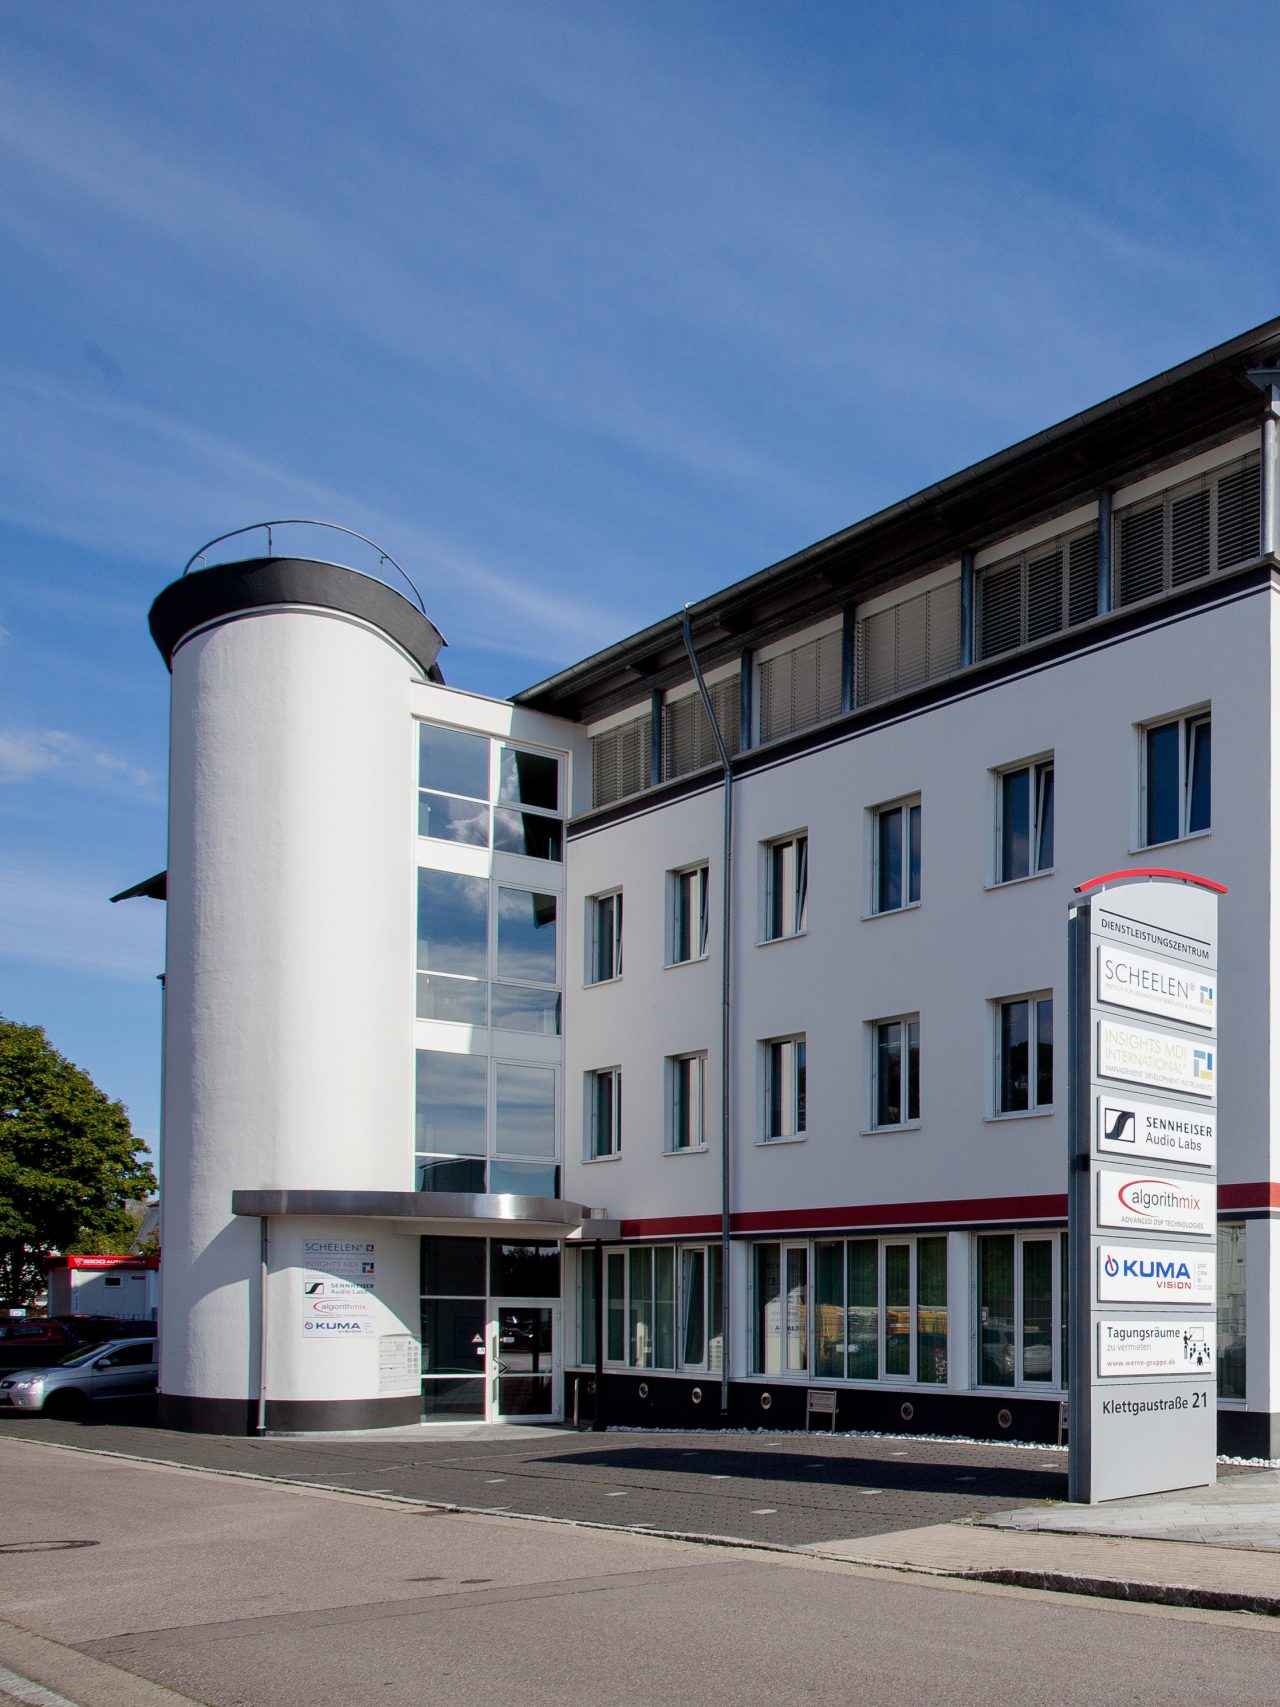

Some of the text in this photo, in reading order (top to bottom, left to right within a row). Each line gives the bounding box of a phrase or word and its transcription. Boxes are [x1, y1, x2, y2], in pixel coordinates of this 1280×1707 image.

[1101, 918, 1210, 960] DIENSTLEISTUNGSZENTRUM
[1105, 1028, 1187, 1060] INSIGHTS MDI
[1105, 1064, 1213, 1092] MANAGEMENT DEVELOPMENT INSTRUMENTS
[1146, 1116, 1213, 1137] SENNHEISER
[1145, 1132, 1202, 1151] Audio Labs
[1131, 1189, 1201, 1210] algorithmix
[1120, 1216, 1204, 1230] ADVANCED DSP TECHNOLOGIES
[1123, 1259, 1191, 1279] KUMA
[1156, 1280, 1192, 1289] VISION
[321, 1303, 366, 1311] algorithmix
[315, 1322, 361, 1330] KUMA
[1106, 1326, 1181, 1341] Tagungsräume
[1117, 1343, 1152, 1351] vermieten
[1102, 1391, 1207, 1416] Klettgaustraße 21
